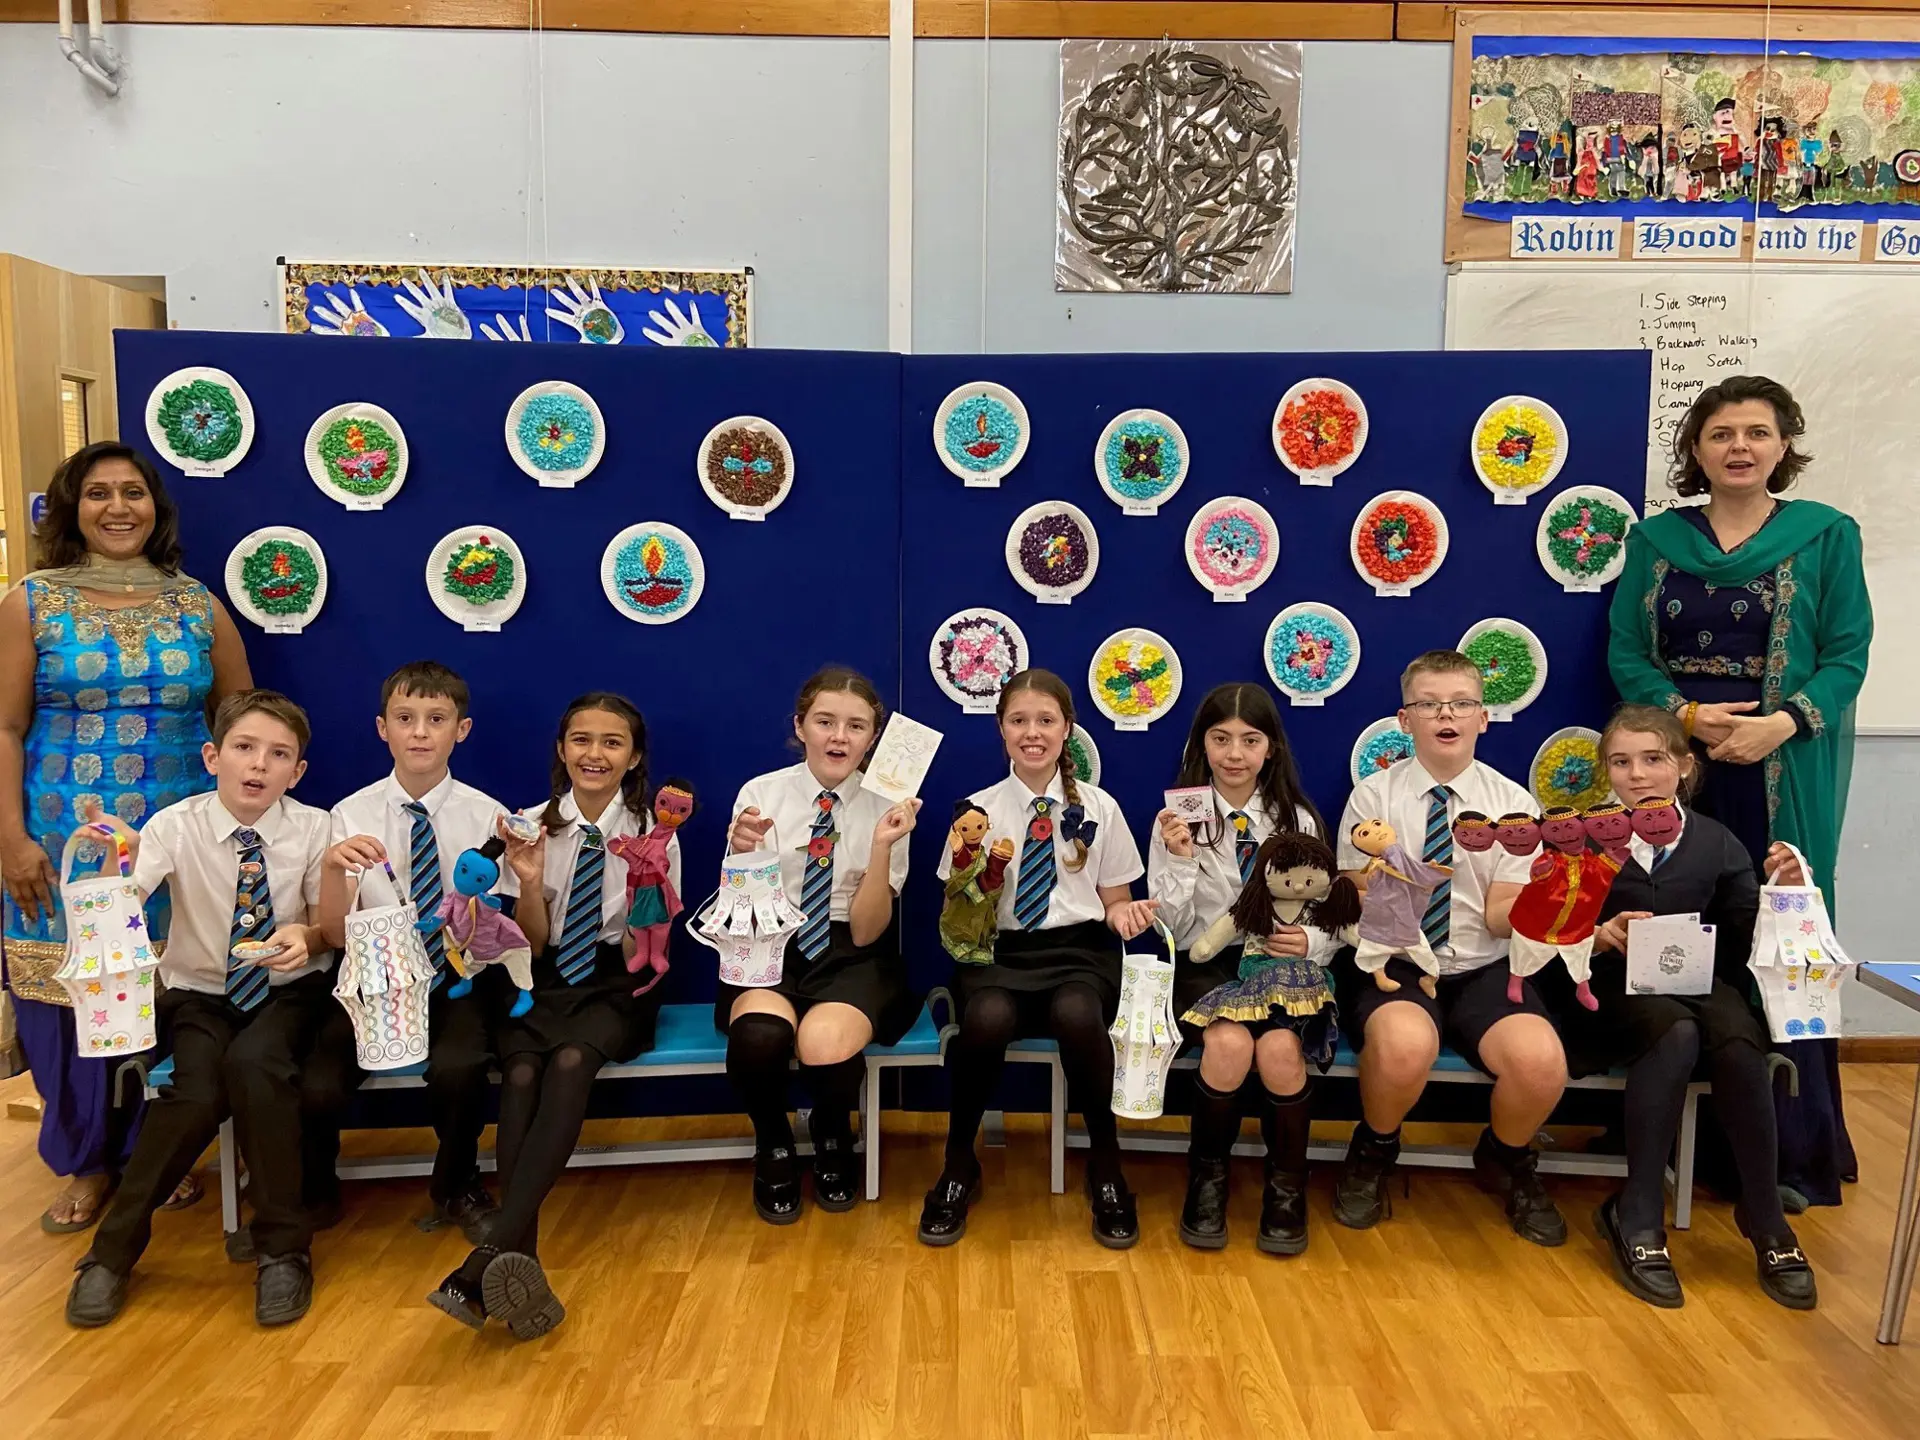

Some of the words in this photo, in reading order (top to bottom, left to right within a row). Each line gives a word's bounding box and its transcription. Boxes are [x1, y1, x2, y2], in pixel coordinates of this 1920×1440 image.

[1515, 221, 1615, 254] Robin
[1639, 222, 1737, 254] Hood
[1758, 225, 1808, 251] and
[1816, 224, 1857, 255] the
[1653, 292, 1680, 310] Side
[1639, 319, 1650, 330] 2.
[1653, 314, 1696, 334] Jumping
[1660, 357, 1685, 373] Hop
[1660, 378, 1703, 392] Hopping
